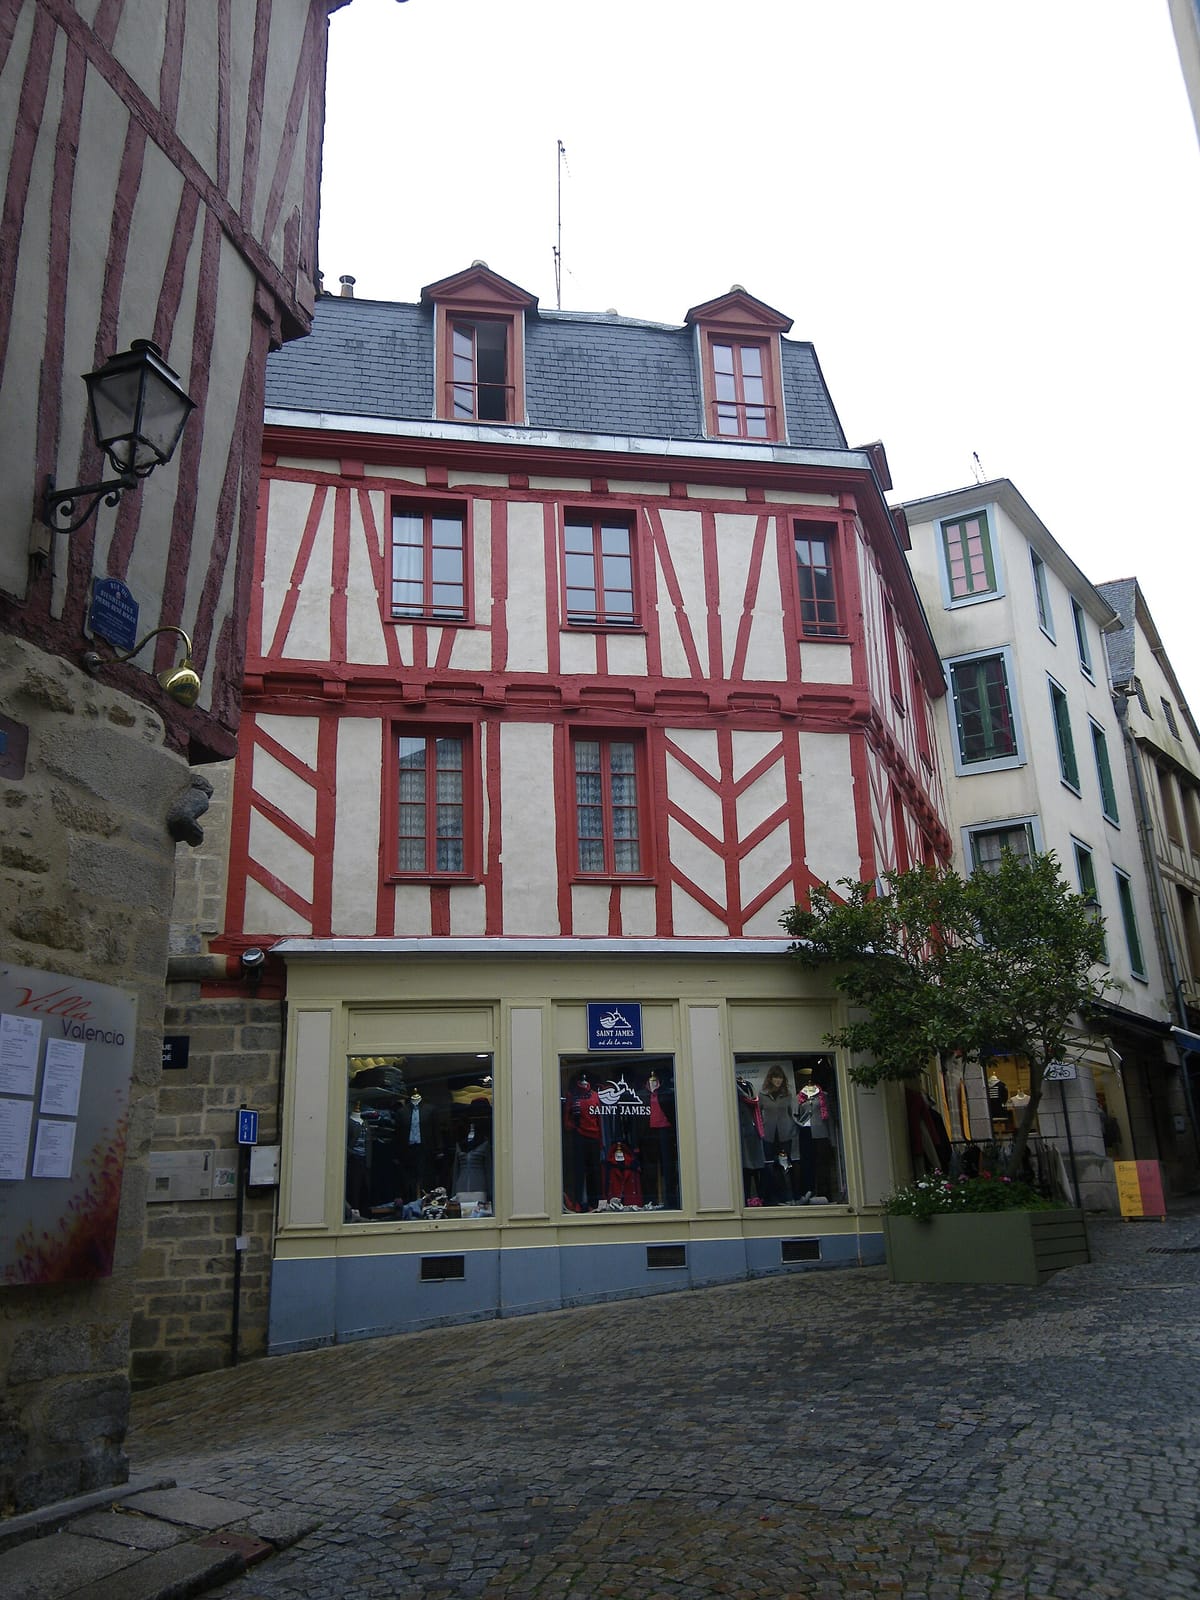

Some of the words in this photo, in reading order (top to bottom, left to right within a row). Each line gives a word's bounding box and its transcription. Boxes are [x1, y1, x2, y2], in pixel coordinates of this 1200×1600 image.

[15, 986, 96, 1021] Villa
[62, 1019, 125, 1046] Valencia
[589, 1105, 617, 1115] SAINT
[620, 1105, 651, 1115] JAMES
